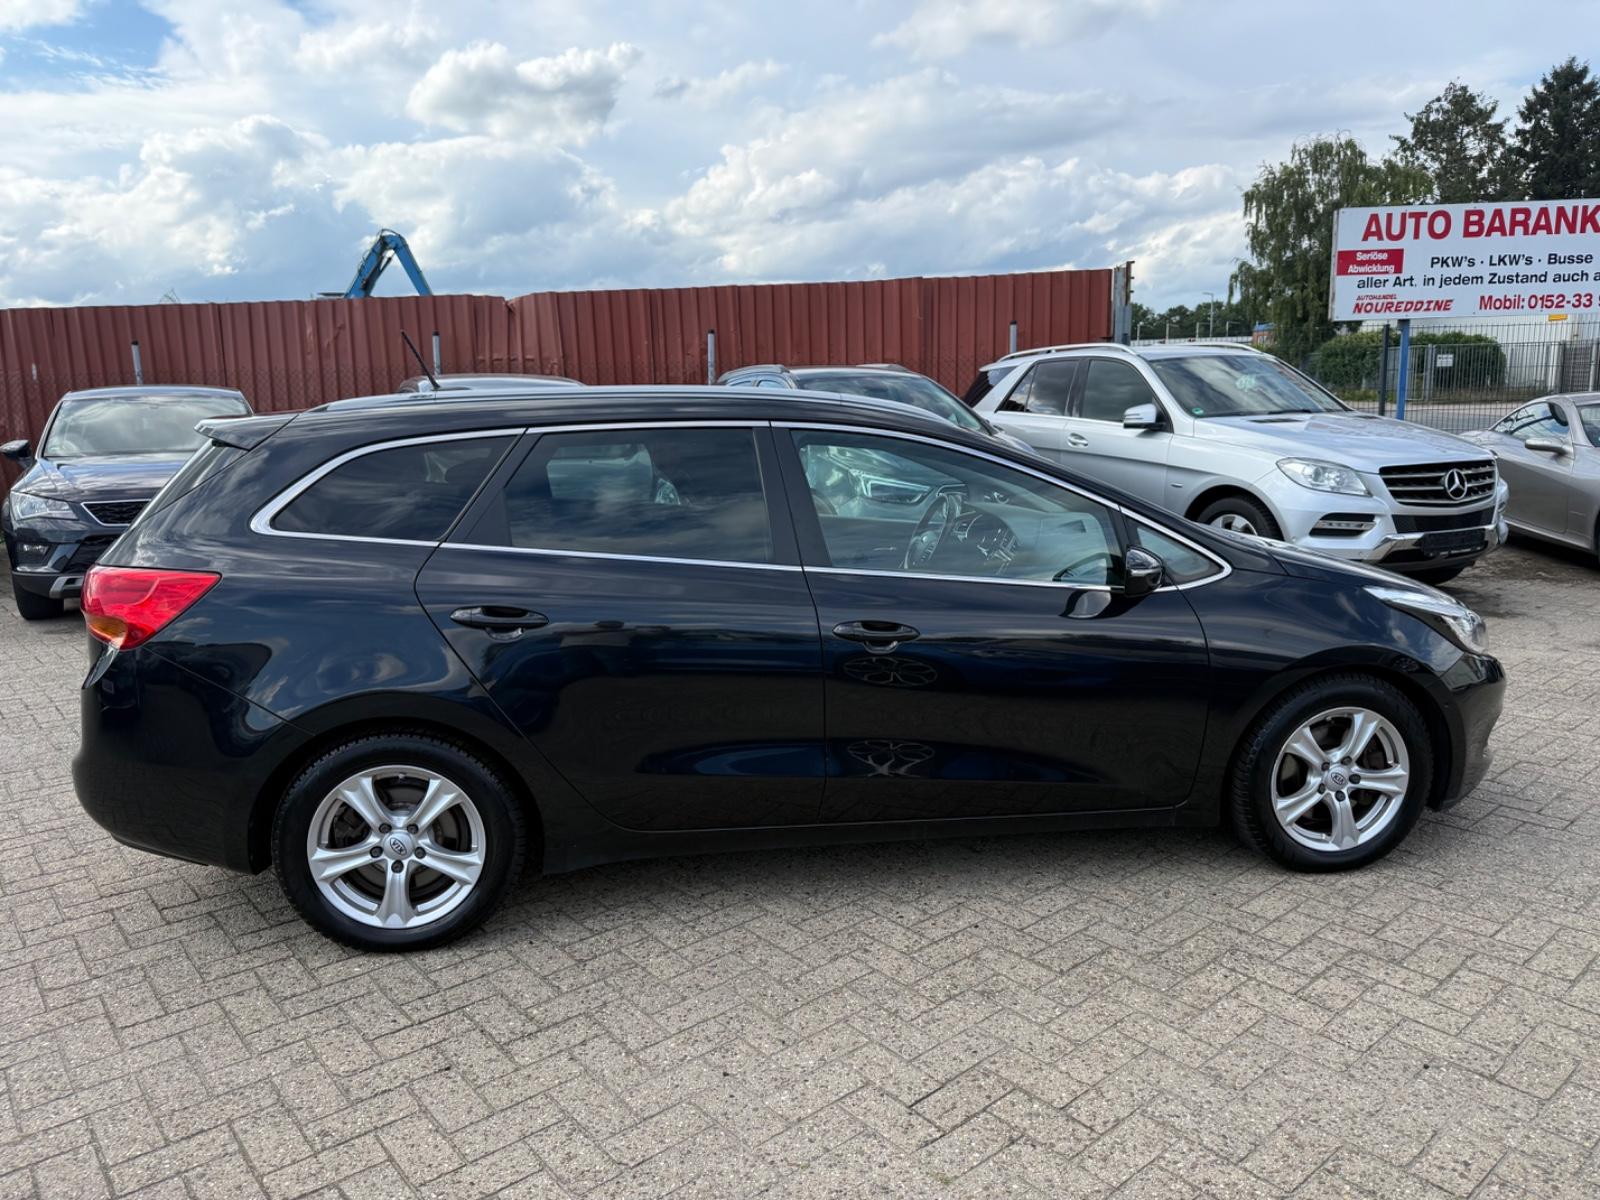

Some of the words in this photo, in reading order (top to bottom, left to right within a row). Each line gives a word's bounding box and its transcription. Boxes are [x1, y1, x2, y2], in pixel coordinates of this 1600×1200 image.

[1361, 209, 1452, 242] AUTO
[1356, 251, 1388, 261] Seriöse
[1547, 252, 1594, 265] Busse
[1347, 263, 1395, 274] Abwicklung
[1357, 276, 1389, 289] aller
[1423, 274, 1435, 287] in
[1438, 273, 1484, 288] jedem
[1488, 271, 1548, 285] Zustand
[1552, 270, 1589, 283] auch
[1352, 299, 1454, 314] NOUREDDINE
[1479, 296, 1525, 311] Mobil:
[1527, 292, 1593, 310] 0152-33
